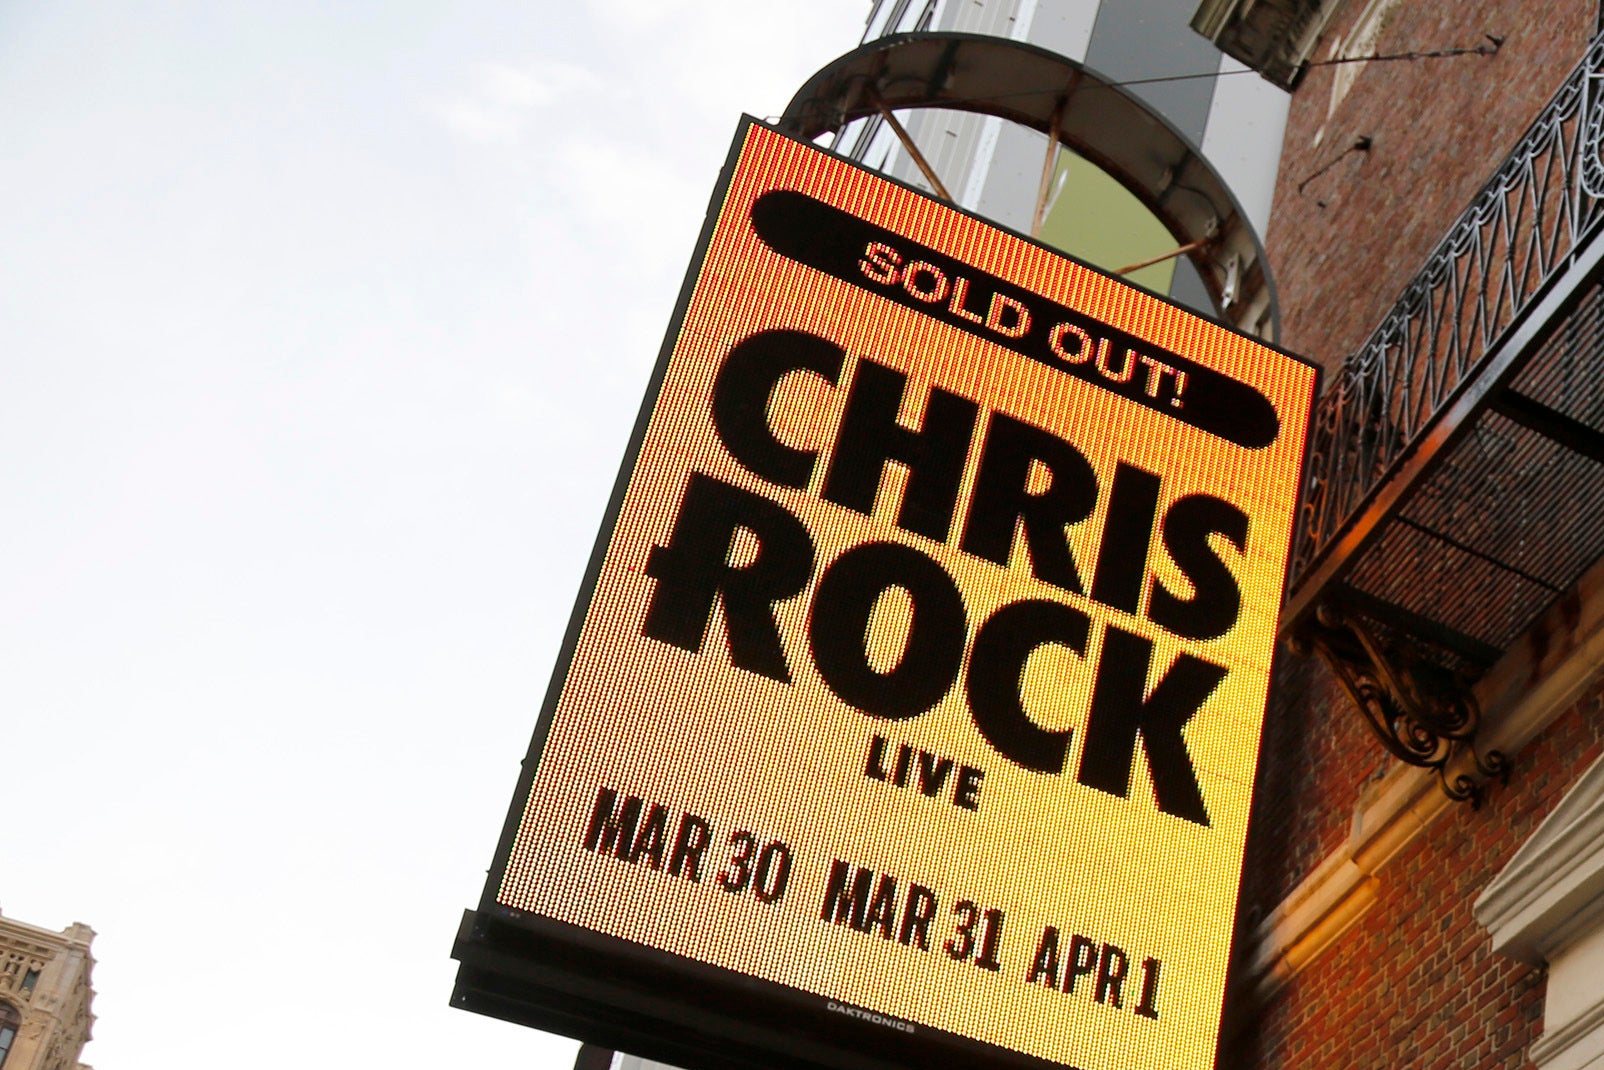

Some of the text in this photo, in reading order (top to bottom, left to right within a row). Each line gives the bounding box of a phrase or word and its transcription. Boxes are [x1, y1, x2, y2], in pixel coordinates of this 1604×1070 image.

[858, 241, 1189, 408] SOLD OUT!
[711, 328, 1250, 642] CHRIS
[641, 472, 1229, 828] ROCK
[864, 735, 985, 812] LIVE
[583, 786, 1162, 1021] MAR 30 MAR 31 APR 1
[826, 1001, 916, 1034] DAKTRONICS
